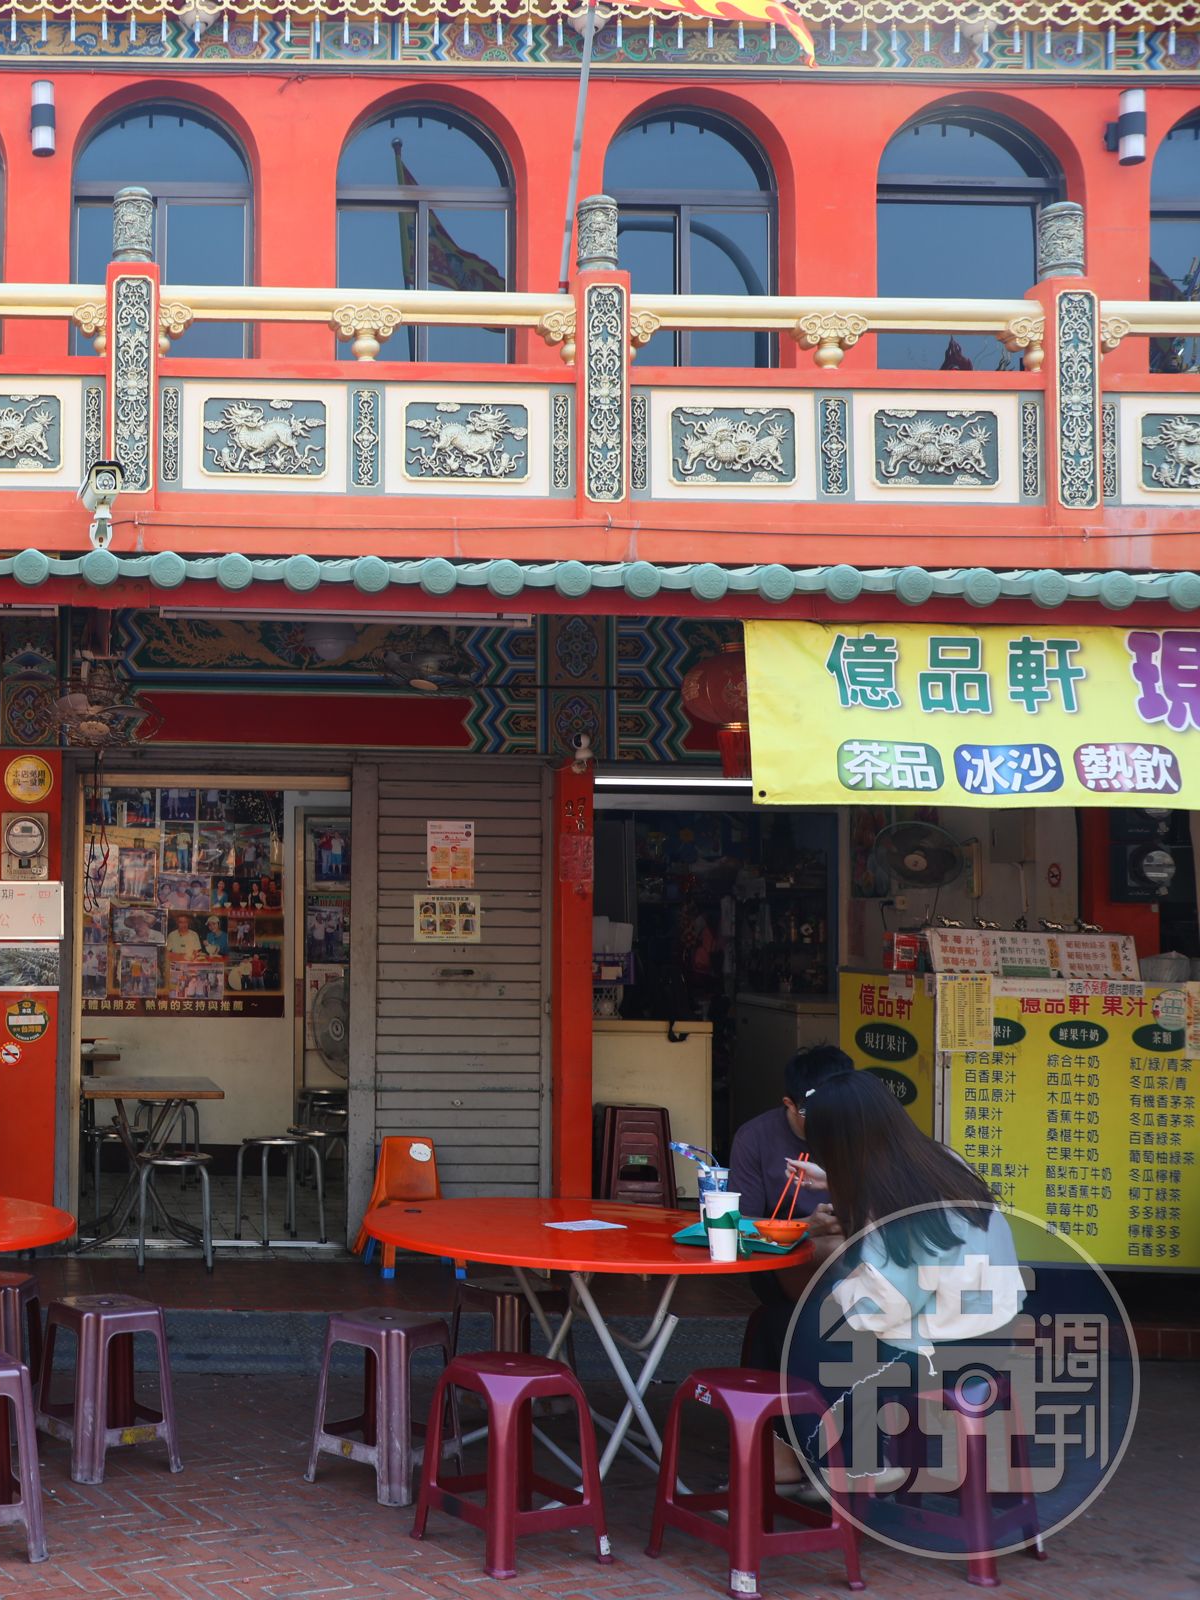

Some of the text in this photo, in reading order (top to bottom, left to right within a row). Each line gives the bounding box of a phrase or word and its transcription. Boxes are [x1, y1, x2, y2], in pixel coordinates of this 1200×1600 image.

[825, 632, 1088, 715] 億品軒
[842, 740, 939, 790] 茶品
[960, 746, 1057, 794] 冰沙
[1079, 744, 1180, 792] 熱飲
[145, 1000, 244, 1012] 熱情的支持與推薦
[859, 983, 913, 1020] 億品軒
[1102, 995, 1150, 1018] 果汁
[1058, 1027, 1100, 1042] 鮮果牛奶
[864, 1032, 907, 1054] 現打果汁
[964, 1052, 1017, 1066] 綜合果汁
[1047, 1054, 1100, 1070] 綜合牛奶
[1130, 1057, 1193, 1073] 紅/綠/青茶
[964, 1070, 1017, 1084] 百香果汁
[1047, 1072, 1100, 1087] 西瓜牛奶
[1129, 1076, 1187, 1091] 冬瓜茶/青
[964, 1088, 1017, 1103] 西瓜原汁
[1047, 1091, 1100, 1106] 木瓜牛奶
[1129, 1095, 1195, 1110] 有機香茅茶
[964, 1107, 1003, 1121] 蘋果汁
[1047, 1110, 1100, 1125] 香蕉牛奶
[1129, 1113, 1195, 1128] 冬瓜香茅茶
[964, 1125, 1003, 1140] 桑椹汁
[1046, 1128, 1099, 1144] 桑椹牛奶
[1129, 1131, 1182, 1147] 百香綠茶
[964, 1144, 1003, 1158] 芒果汁
[1046, 1147, 1099, 1162] 芒果牛奶
[1129, 1150, 1195, 1166] 葡萄柚綠茶
[1046, 1165, 1112, 1181] 酪梨布丁牛奶
[1129, 1168, 1182, 1184] 冬瓜檸檬
[1046, 1184, 1112, 1200] 酪梨香蕉牛奶
[1129, 1187, 1182, 1202] 柳丁綠茶
[1046, 1202, 1099, 1218] 草莓牛奶
[1128, 1205, 1181, 1221] 多多綠茶
[1046, 1221, 1098, 1237] 葡萄牛奶
[1128, 1224, 1181, 1239] 檸檬多多
[1128, 1242, 1181, 1258] 百香多多
